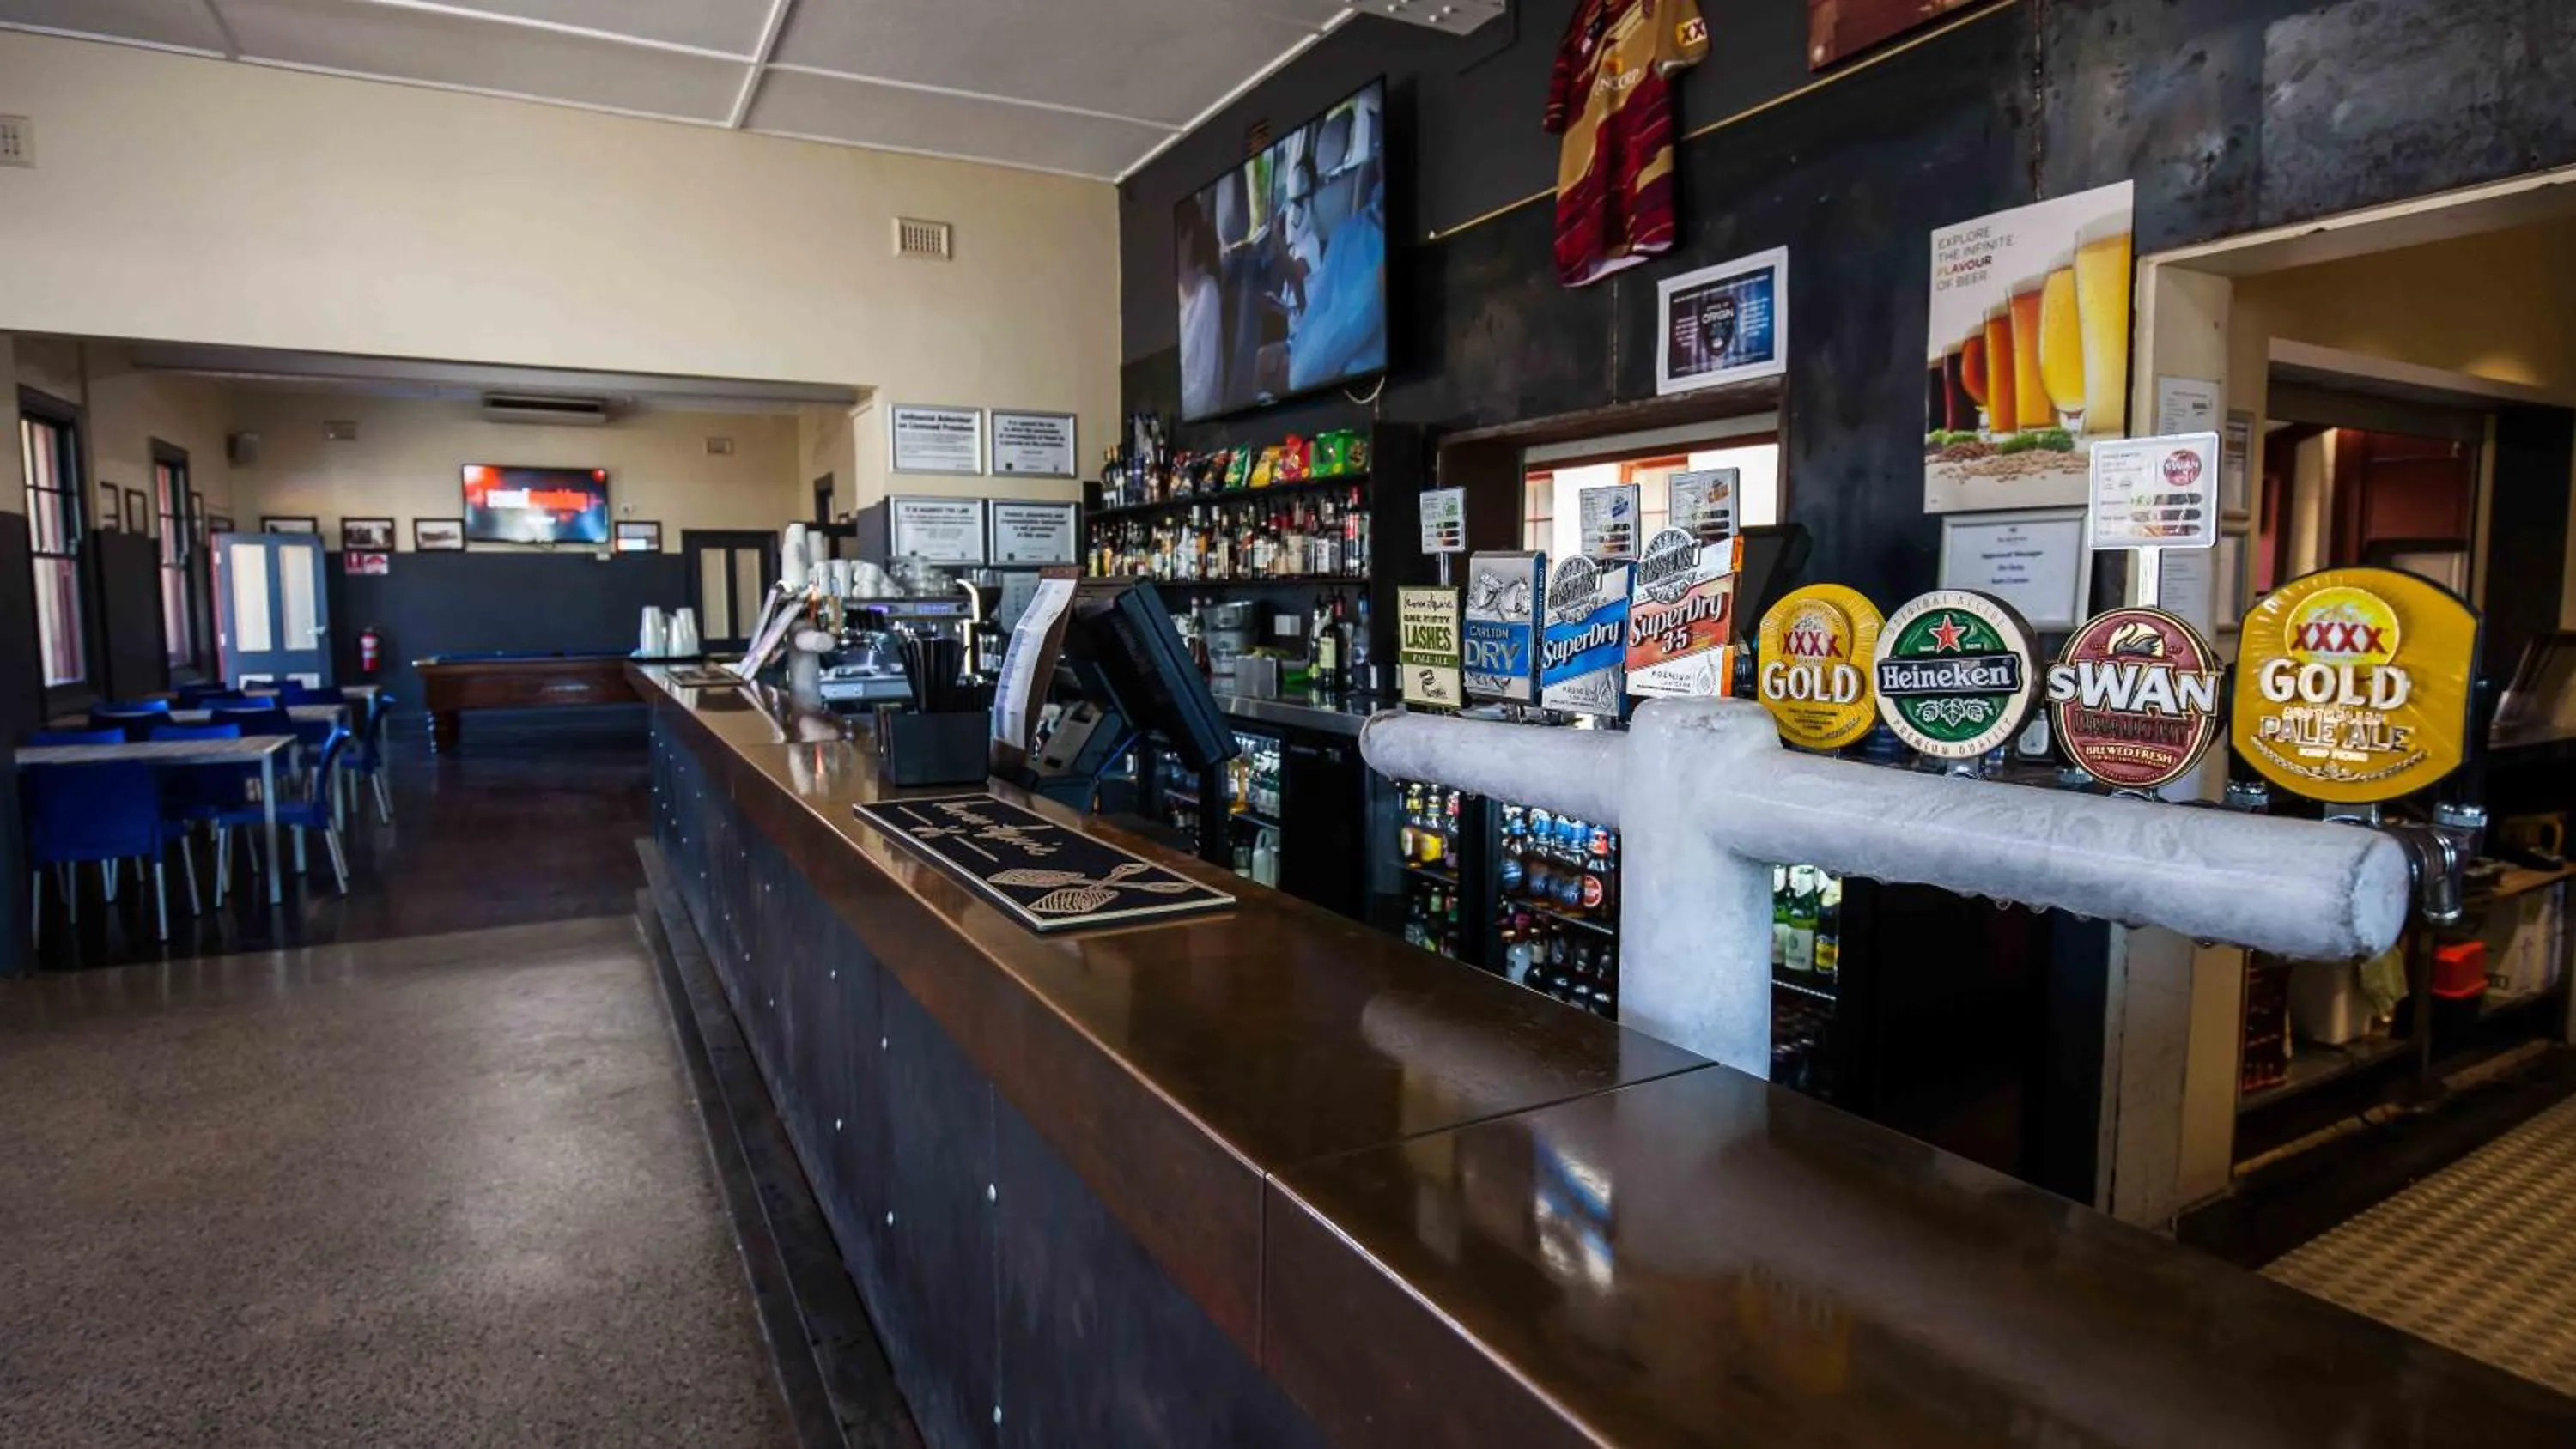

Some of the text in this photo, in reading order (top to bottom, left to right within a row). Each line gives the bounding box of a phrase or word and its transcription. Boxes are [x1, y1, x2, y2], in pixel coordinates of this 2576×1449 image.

[1938, 226, 1992, 250] EXPLORE
[1939, 233, 2014, 262] THE INFINITE
[1937, 255, 1992, 277] FLAVOUR
[1937, 270, 1988, 291] OF BEER
[1469, 627, 1509, 640] CARLTON
[1629, 592, 1723, 646] SuperDry
[1404, 624, 1452, 652] LASHES
[1542, 621, 1619, 670] SuperDry
[1782, 631, 1843, 658] XXXX
[2291, 622, 2386, 654] XXXX
[1464, 639, 1522, 670] DRY
[1762, 659, 1862, 705] GOLD
[1881, 662, 2012, 690] Heineken
[2048, 661, 2215, 716] SWAN
[2259, 658, 2410, 711] GOLD
[1893, 717, 2013, 755] PREMIUM QUALITY
[2259, 715, 2415, 752] PALE ALE
[2086, 745, 2135, 757] BREWED
[2136, 748, 2172, 765] FRESH
